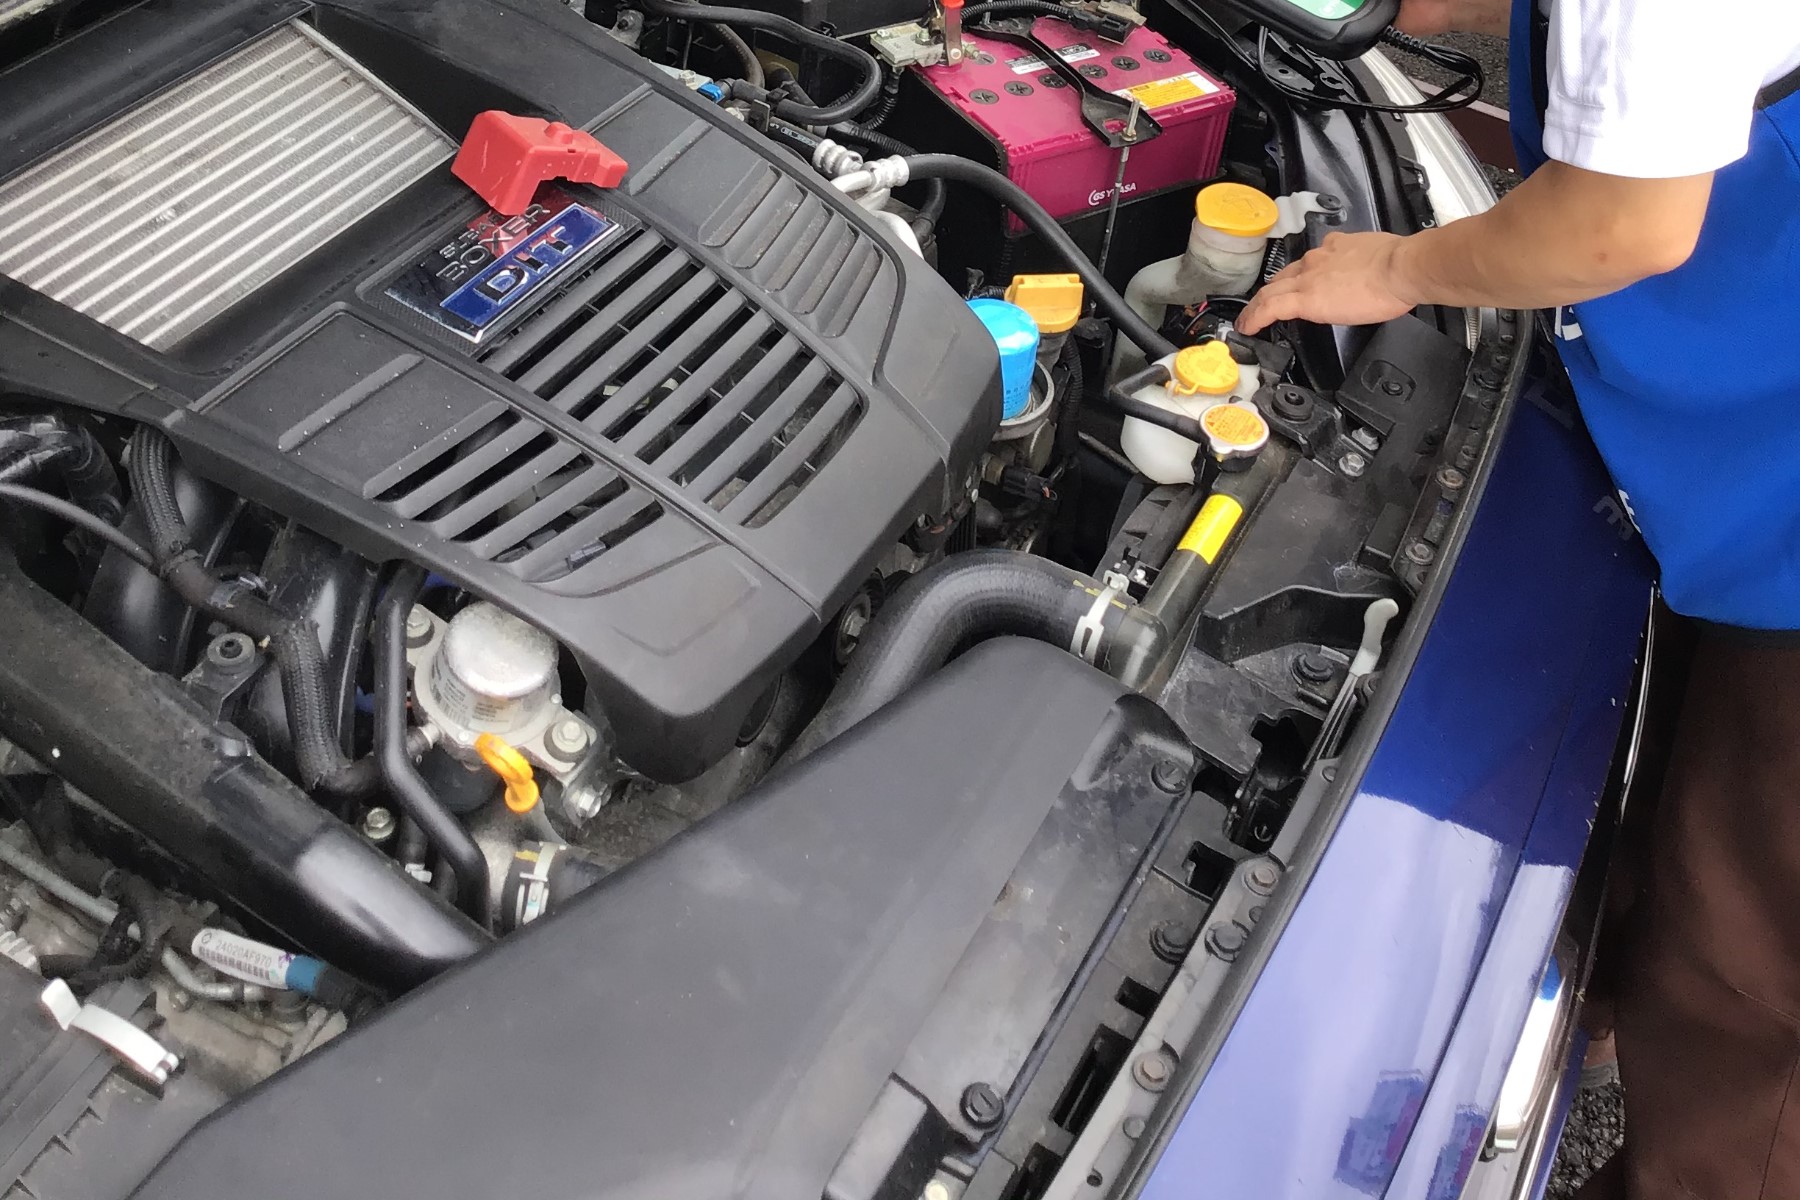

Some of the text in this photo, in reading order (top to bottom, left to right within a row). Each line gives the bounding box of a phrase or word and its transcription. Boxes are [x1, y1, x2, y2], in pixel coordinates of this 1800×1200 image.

[1106, 182, 1136, 197] YASA
[436, 203, 551, 282] BOXER
[472, 224, 574, 305] DIT
